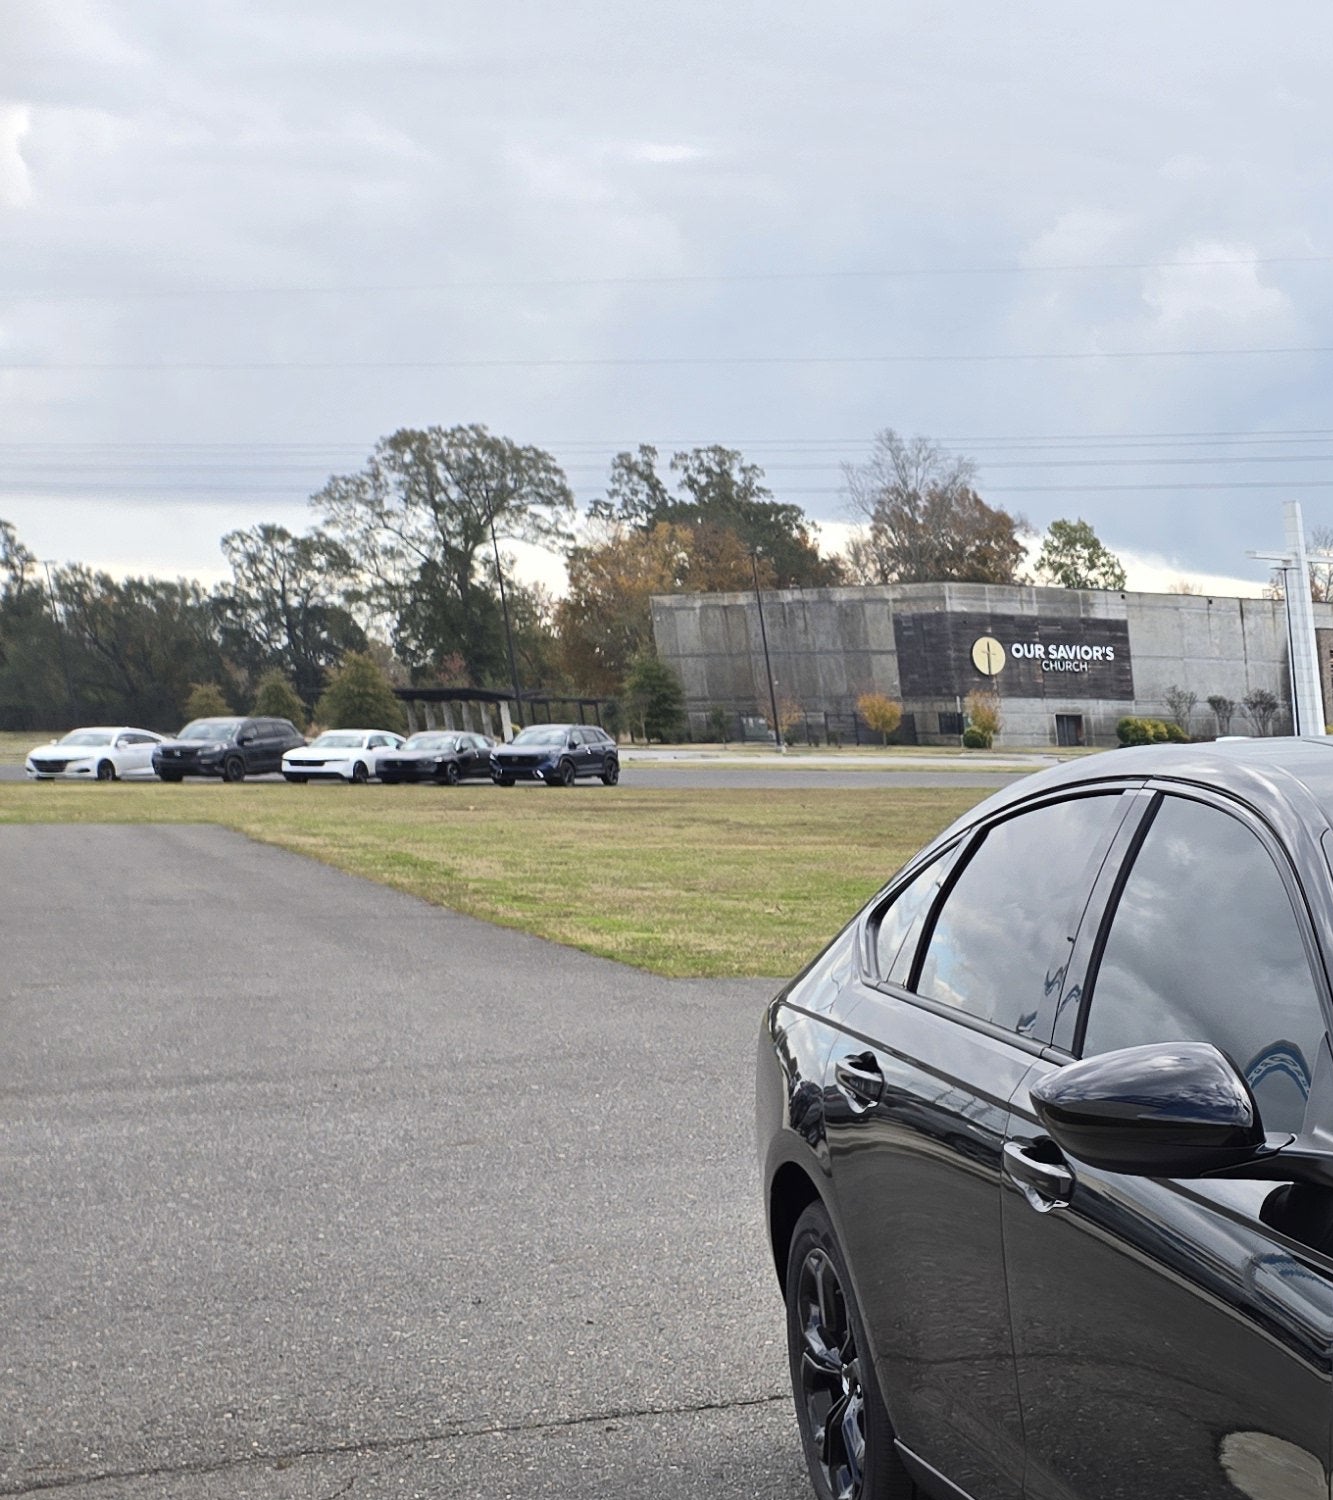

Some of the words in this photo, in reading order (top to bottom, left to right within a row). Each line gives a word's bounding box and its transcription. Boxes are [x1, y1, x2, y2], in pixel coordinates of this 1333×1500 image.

[1011, 643, 1046, 660] OUR
[1048, 644, 1115, 661] SAVIOR'S
[1042, 660, 1089, 672] CHURCH
